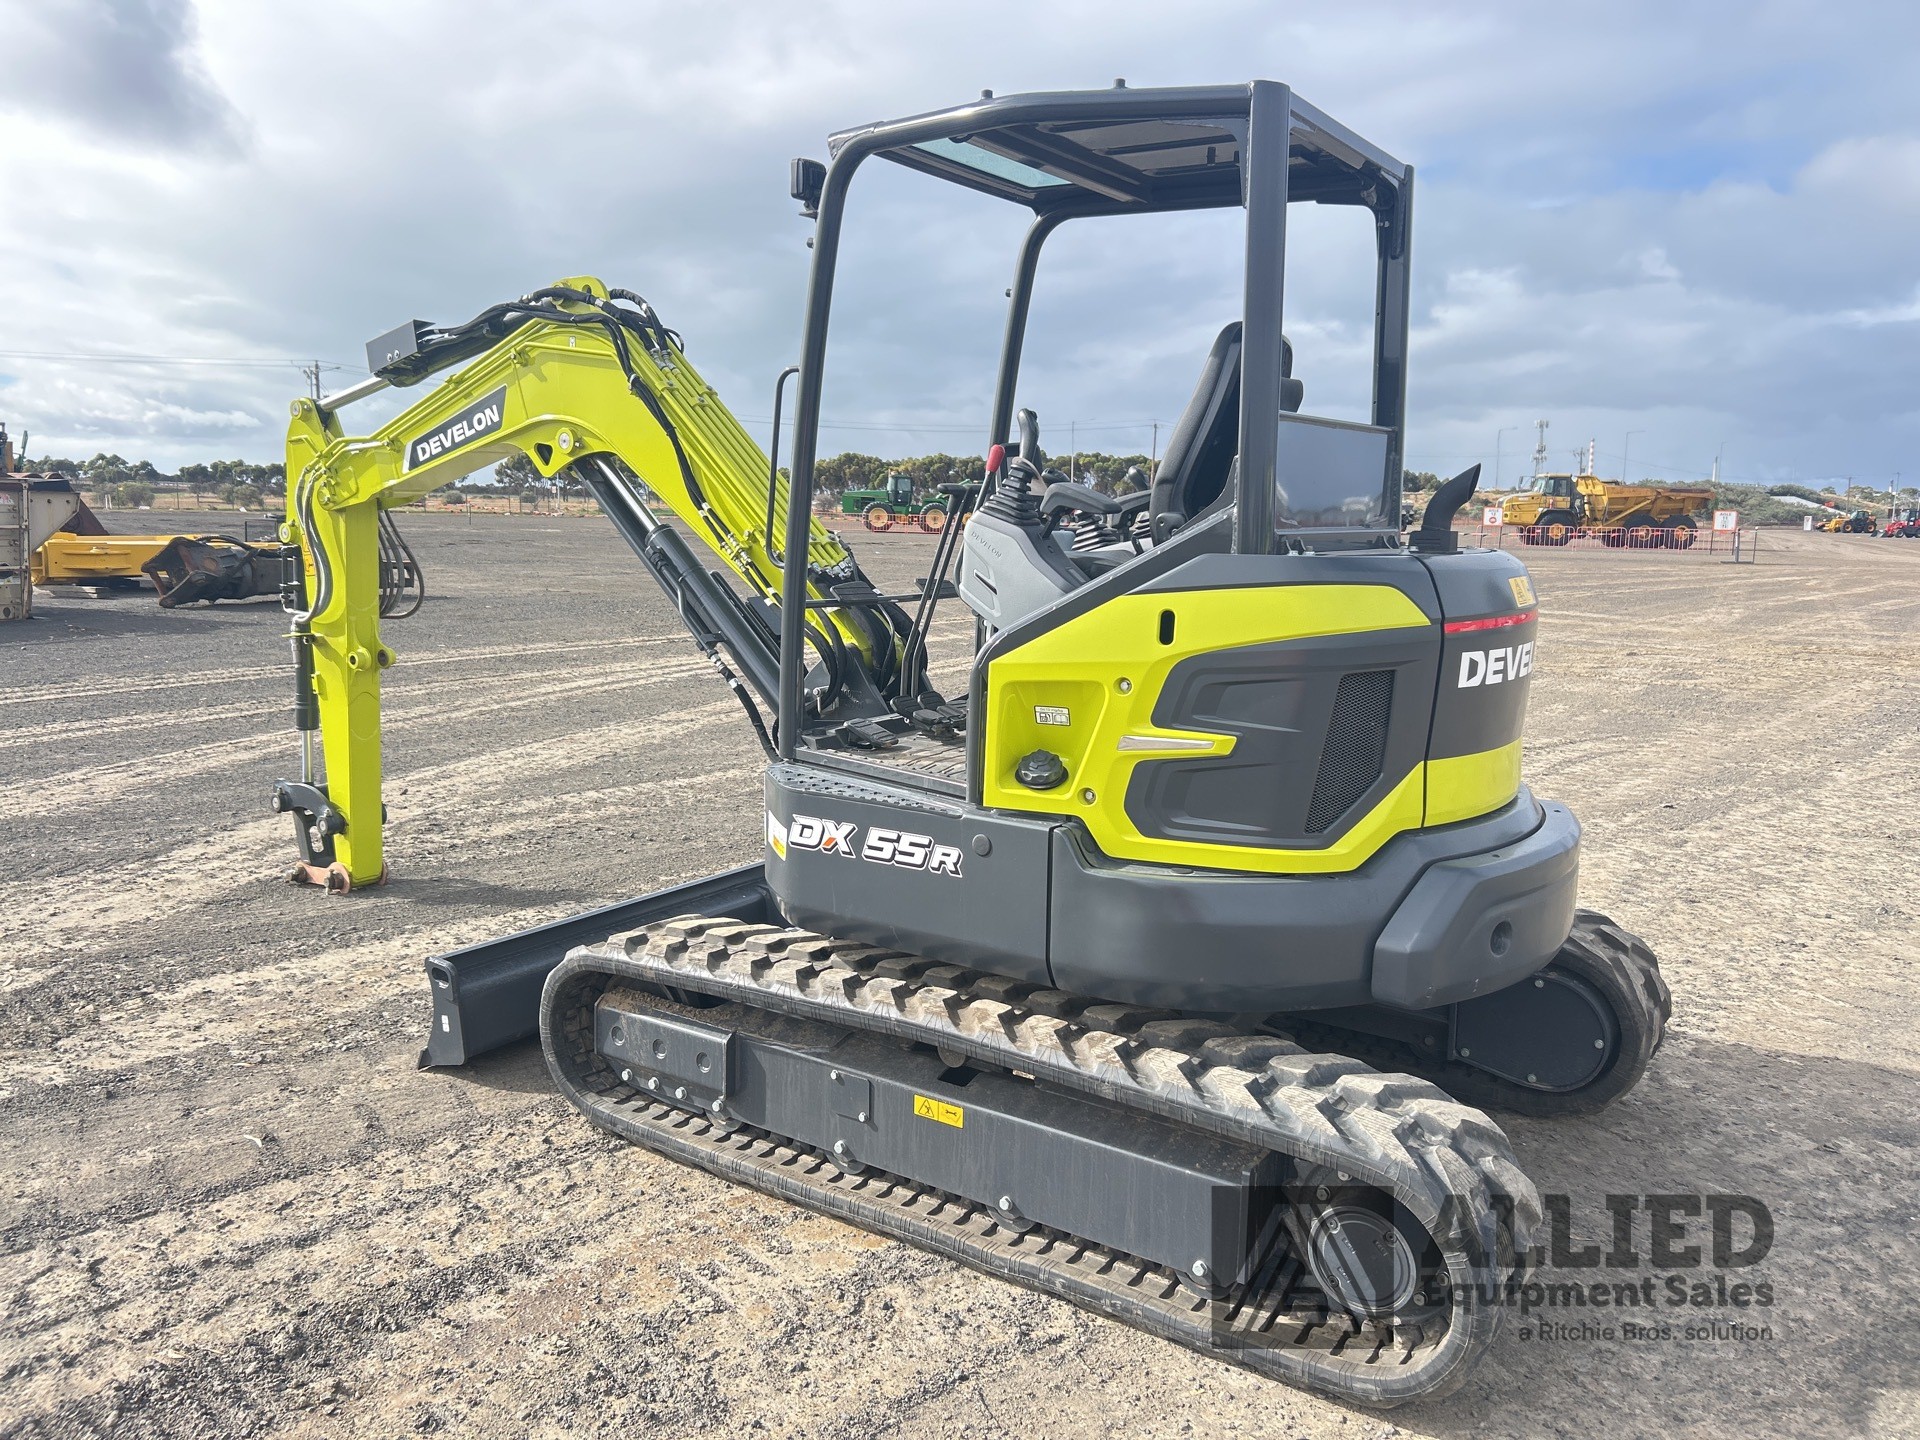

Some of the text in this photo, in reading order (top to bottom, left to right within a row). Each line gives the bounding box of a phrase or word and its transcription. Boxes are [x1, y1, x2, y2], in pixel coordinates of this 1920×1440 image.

[416, 404, 500, 462] DEVELON
[971, 531, 1002, 559] DEVELON
[789, 814, 858, 859] DX
